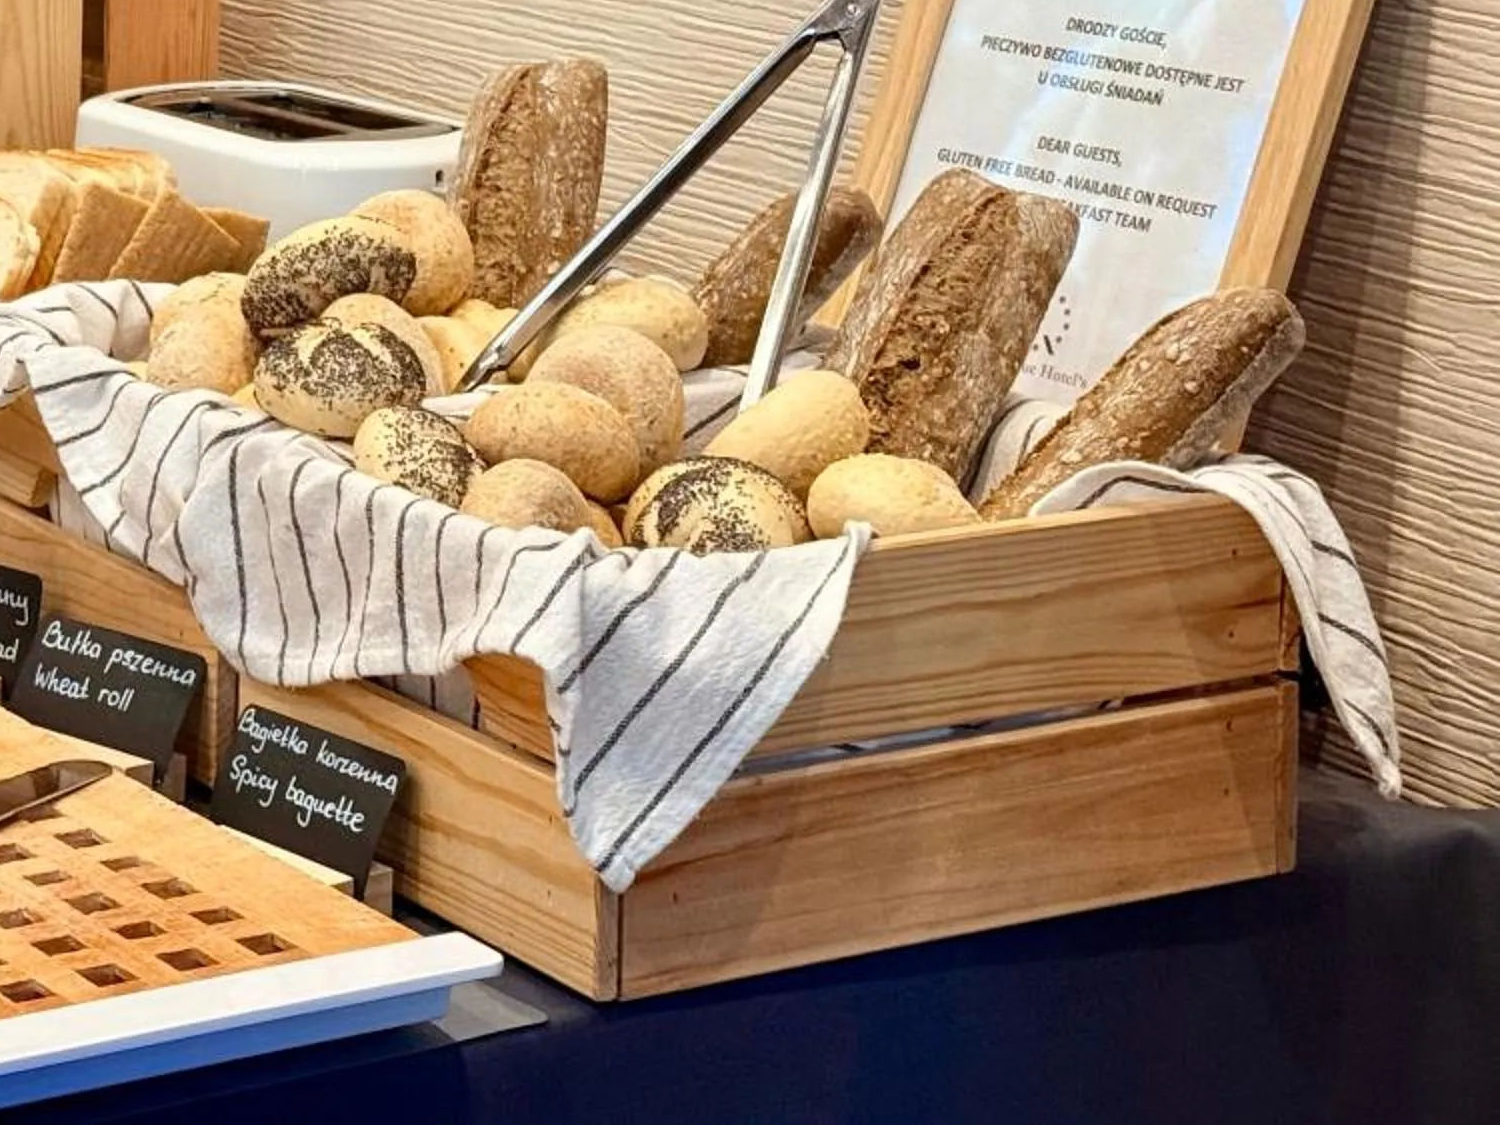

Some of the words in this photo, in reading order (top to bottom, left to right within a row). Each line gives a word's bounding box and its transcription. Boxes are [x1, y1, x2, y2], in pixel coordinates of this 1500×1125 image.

[1066, 16, 1118, 39] DRODZY
[1120, 25, 1168, 49] GOŚCIE,
[981, 34, 1041, 59] PIECZYWO
[1043, 45, 1143, 76] BEZGLUTENOWE
[1145, 62, 1214, 88] DOSTĘPNE
[1214, 77, 1245, 94] JEST
[1037, 70, 1049, 85] U
[1104, 80, 1164, 106] ŚNIADAŃ
[1037, 136, 1071, 154] DEAR
[1073, 142, 1123, 167] GUESTS,
[937, 148, 983, 170] GLUTEN
[984, 158, 1014, 176] FREE
[1016, 164, 1056, 185] BREAD
[1064, 175, 1133, 201] AVAILABLE
[1134, 189, 1155, 206] ON
[1156, 193, 1219, 220] REQUEST
[1115, 210, 1153, 234] TEAM
[35, 662, 91, 701] Wheat
[97, 686, 136, 712] roll
[104, 647, 198, 688] pszenna
[315, 739, 399, 796] korzenna
[229, 754, 279, 808] Spicy
[285, 776, 365, 833] baguette
